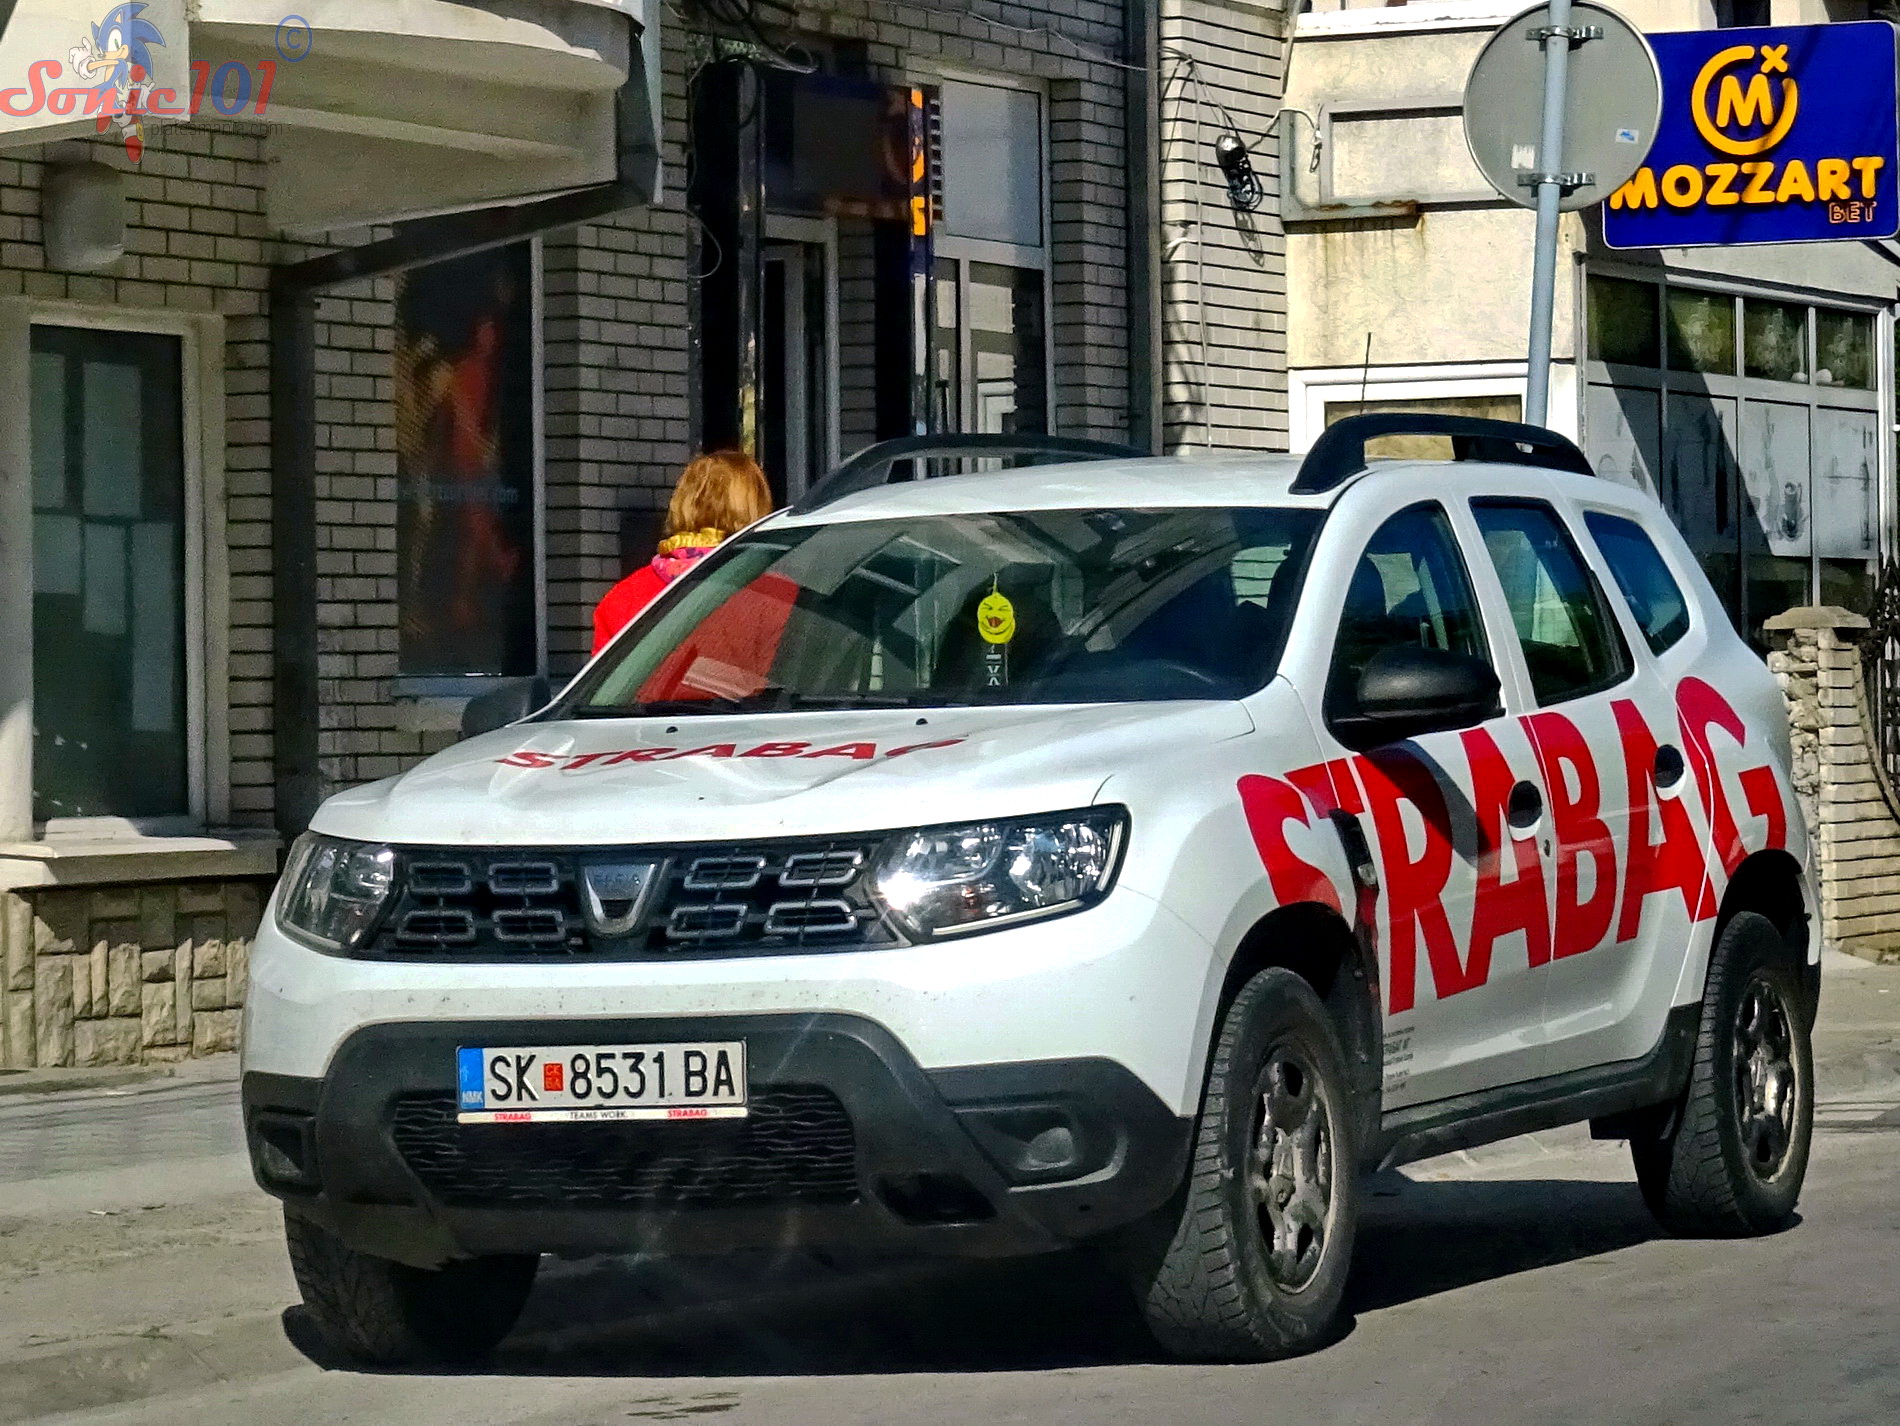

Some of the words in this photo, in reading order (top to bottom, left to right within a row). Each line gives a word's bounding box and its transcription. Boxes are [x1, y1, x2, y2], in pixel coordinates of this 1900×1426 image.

[1609, 156, 1885, 210] MOZZART
[1829, 201, 1877, 224] BET
[1237, 676, 1787, 1017] STRABAG
[489, 1054, 538, 1102] SK
[569, 1051, 666, 1100] 8531
[684, 1050, 736, 1098] BA
[494, 1112, 532, 1121] STRABAG
[570, 1111, 598, 1120] TEAMS
[667, 1108, 708, 1118] STRABAG
